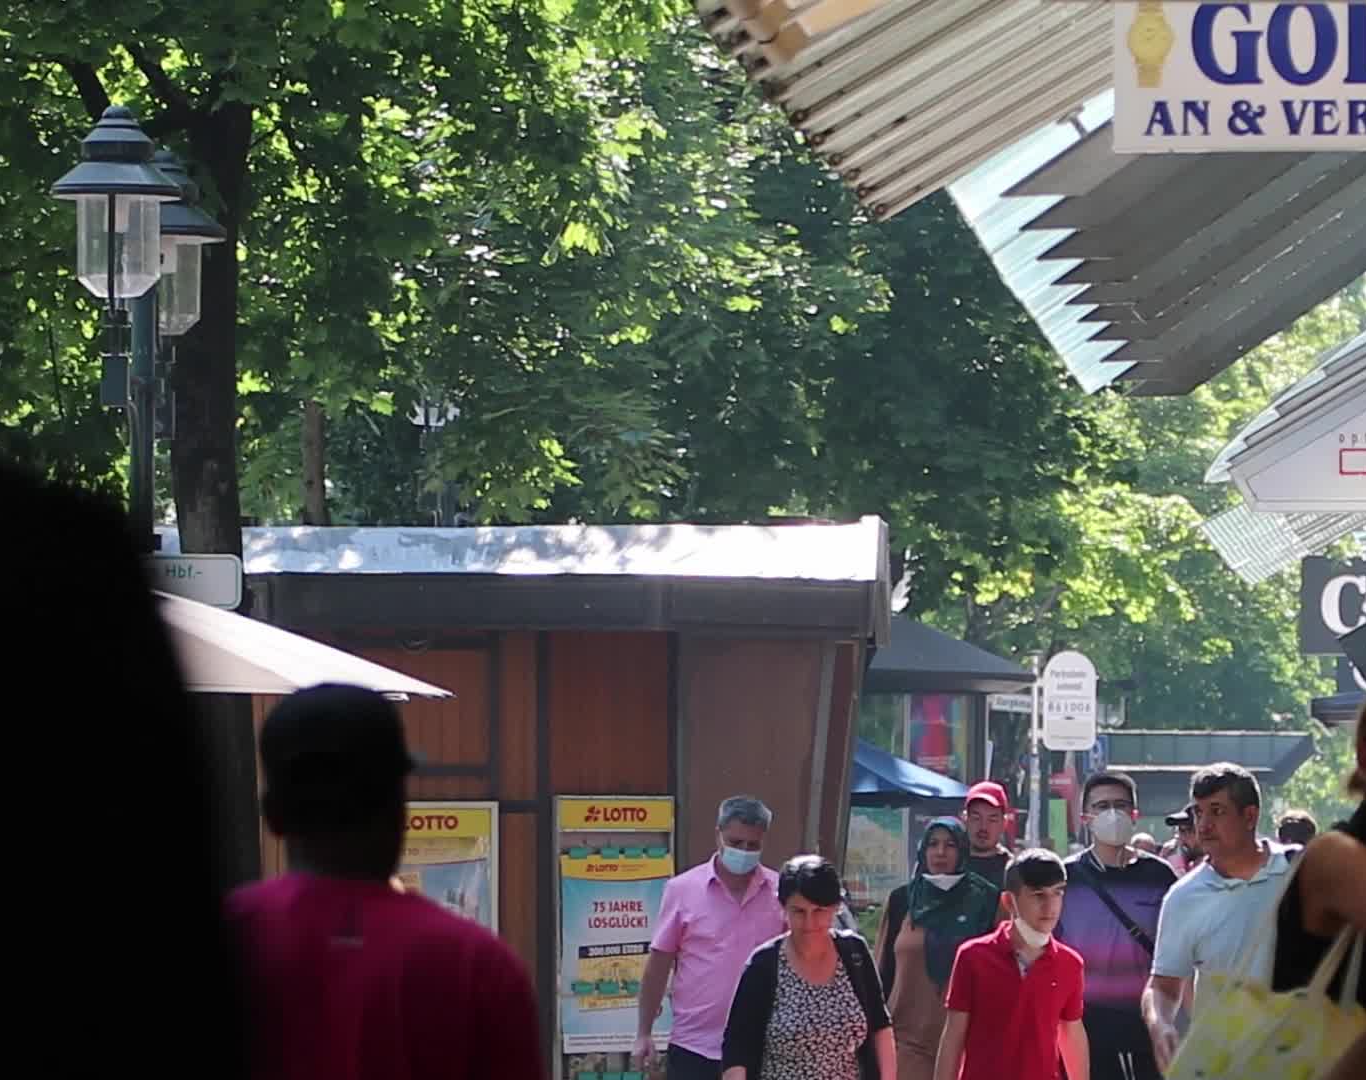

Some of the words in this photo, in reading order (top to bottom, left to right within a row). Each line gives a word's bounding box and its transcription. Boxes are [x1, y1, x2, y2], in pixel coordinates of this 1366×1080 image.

[1143, 100, 1211, 137] AN
[1227, 100, 1266, 137] &
[403, 815, 459, 831] OTTO
[602, 807, 648, 823] LOTTO
[592, 901, 606, 913] 75
[609, 900, 644, 913] JAHRE
[588, 913, 649, 929] LOSGLÜCK!
